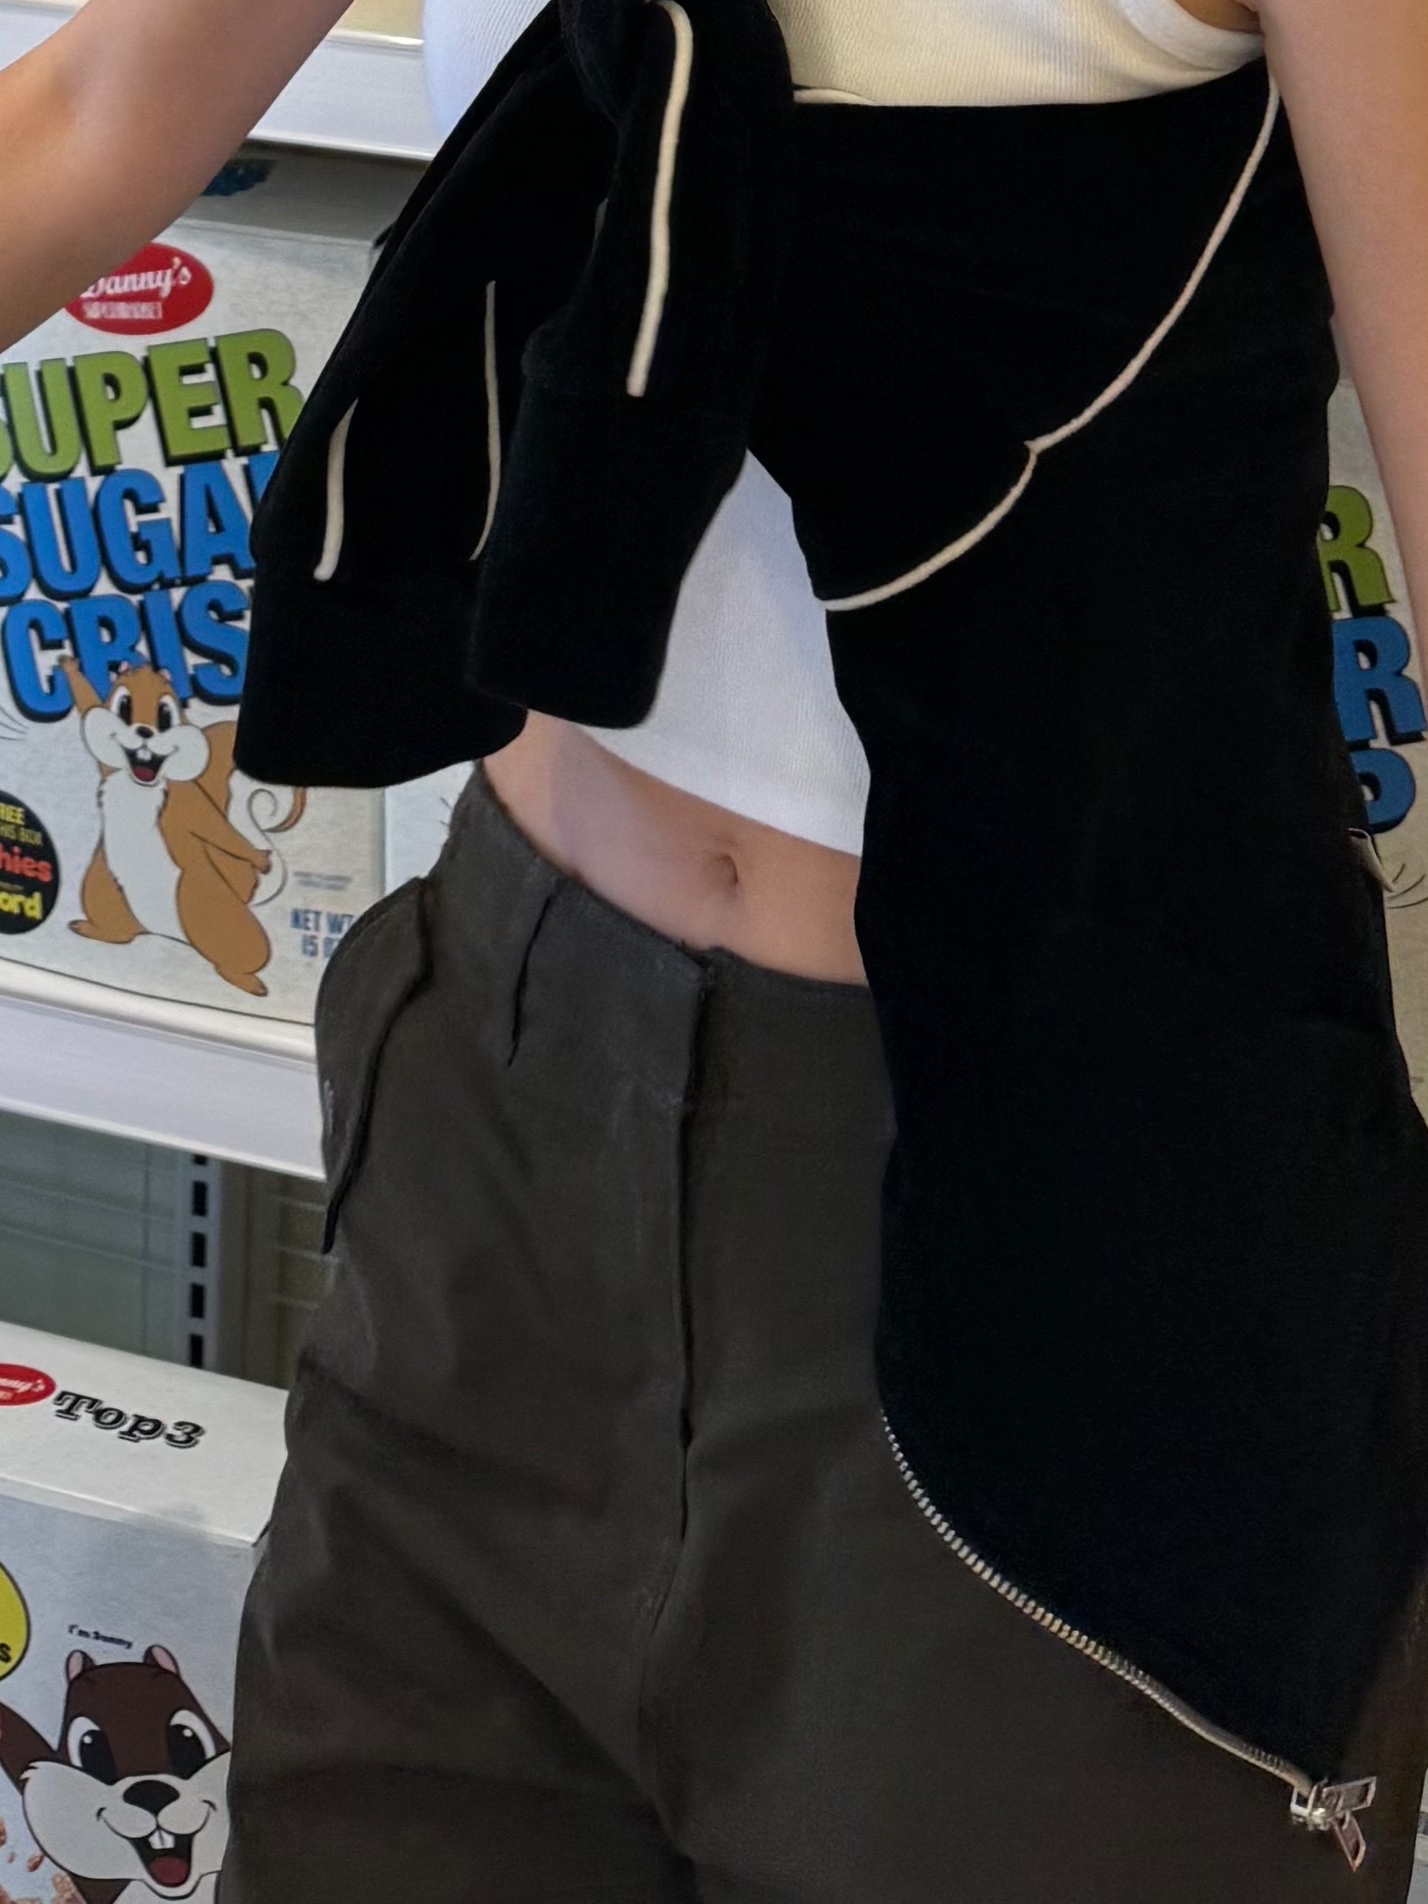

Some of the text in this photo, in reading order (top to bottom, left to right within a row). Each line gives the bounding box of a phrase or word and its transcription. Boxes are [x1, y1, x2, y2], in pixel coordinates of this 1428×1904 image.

[2, 588, 248, 723] CRIS
[291, 908, 322, 935] NET
[52, 1389, 205, 1448] Top3
